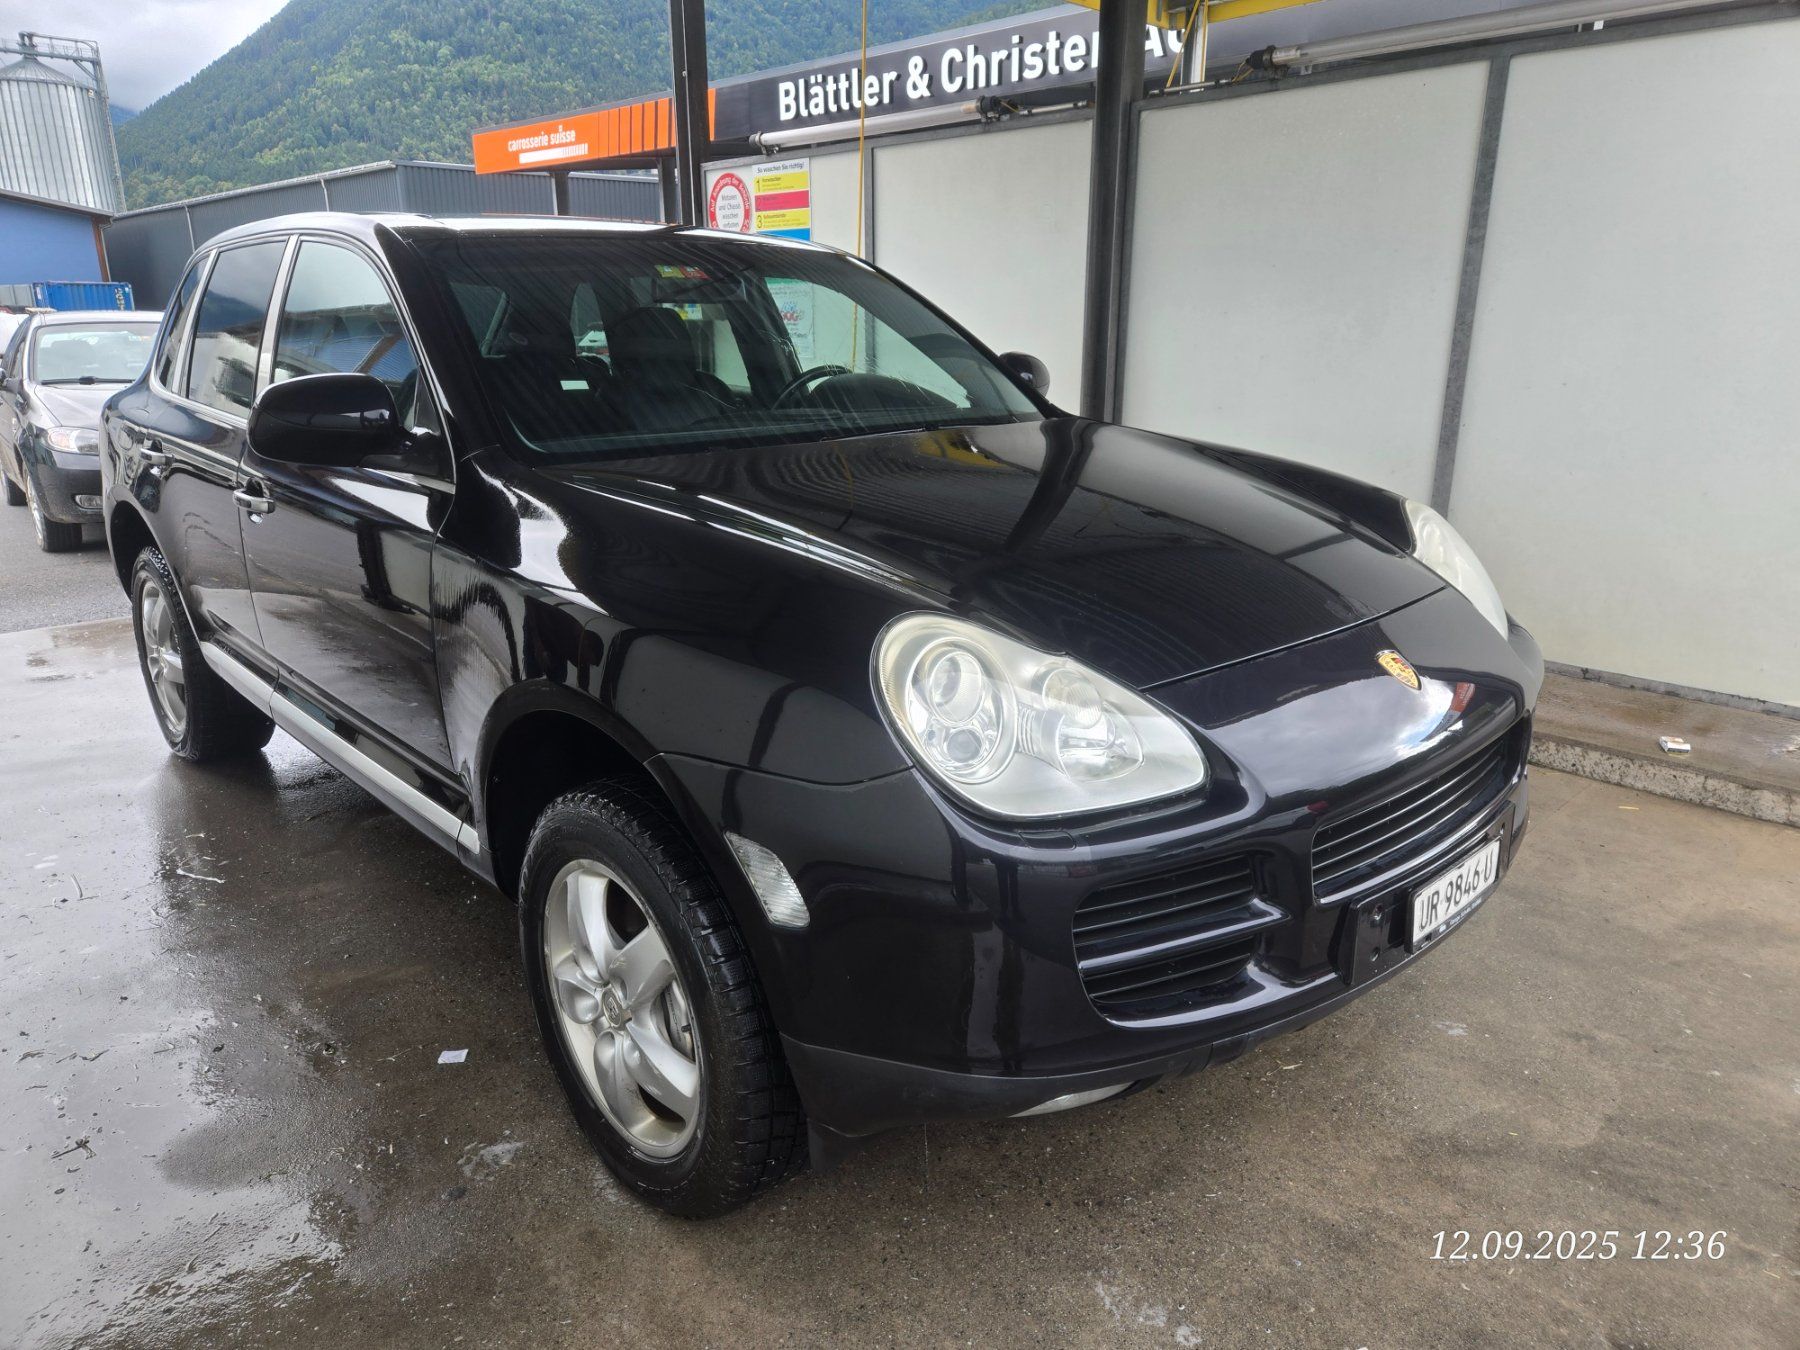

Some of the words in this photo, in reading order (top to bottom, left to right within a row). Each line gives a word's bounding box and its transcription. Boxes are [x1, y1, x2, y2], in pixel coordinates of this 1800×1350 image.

[778, 66, 897, 121] Blättler
[906, 54, 932, 99] &
[507, 131, 549, 153] carrosserie
[549, 124, 577, 146] suisse
[763, 165, 781, 173] waschen
[756, 178, 761, 193] 1
[756, 214, 763, 229] 3
[1419, 889, 1440, 931] UR
[1445, 860, 1480, 914] 9846
[1484, 848, 1494, 883] U
